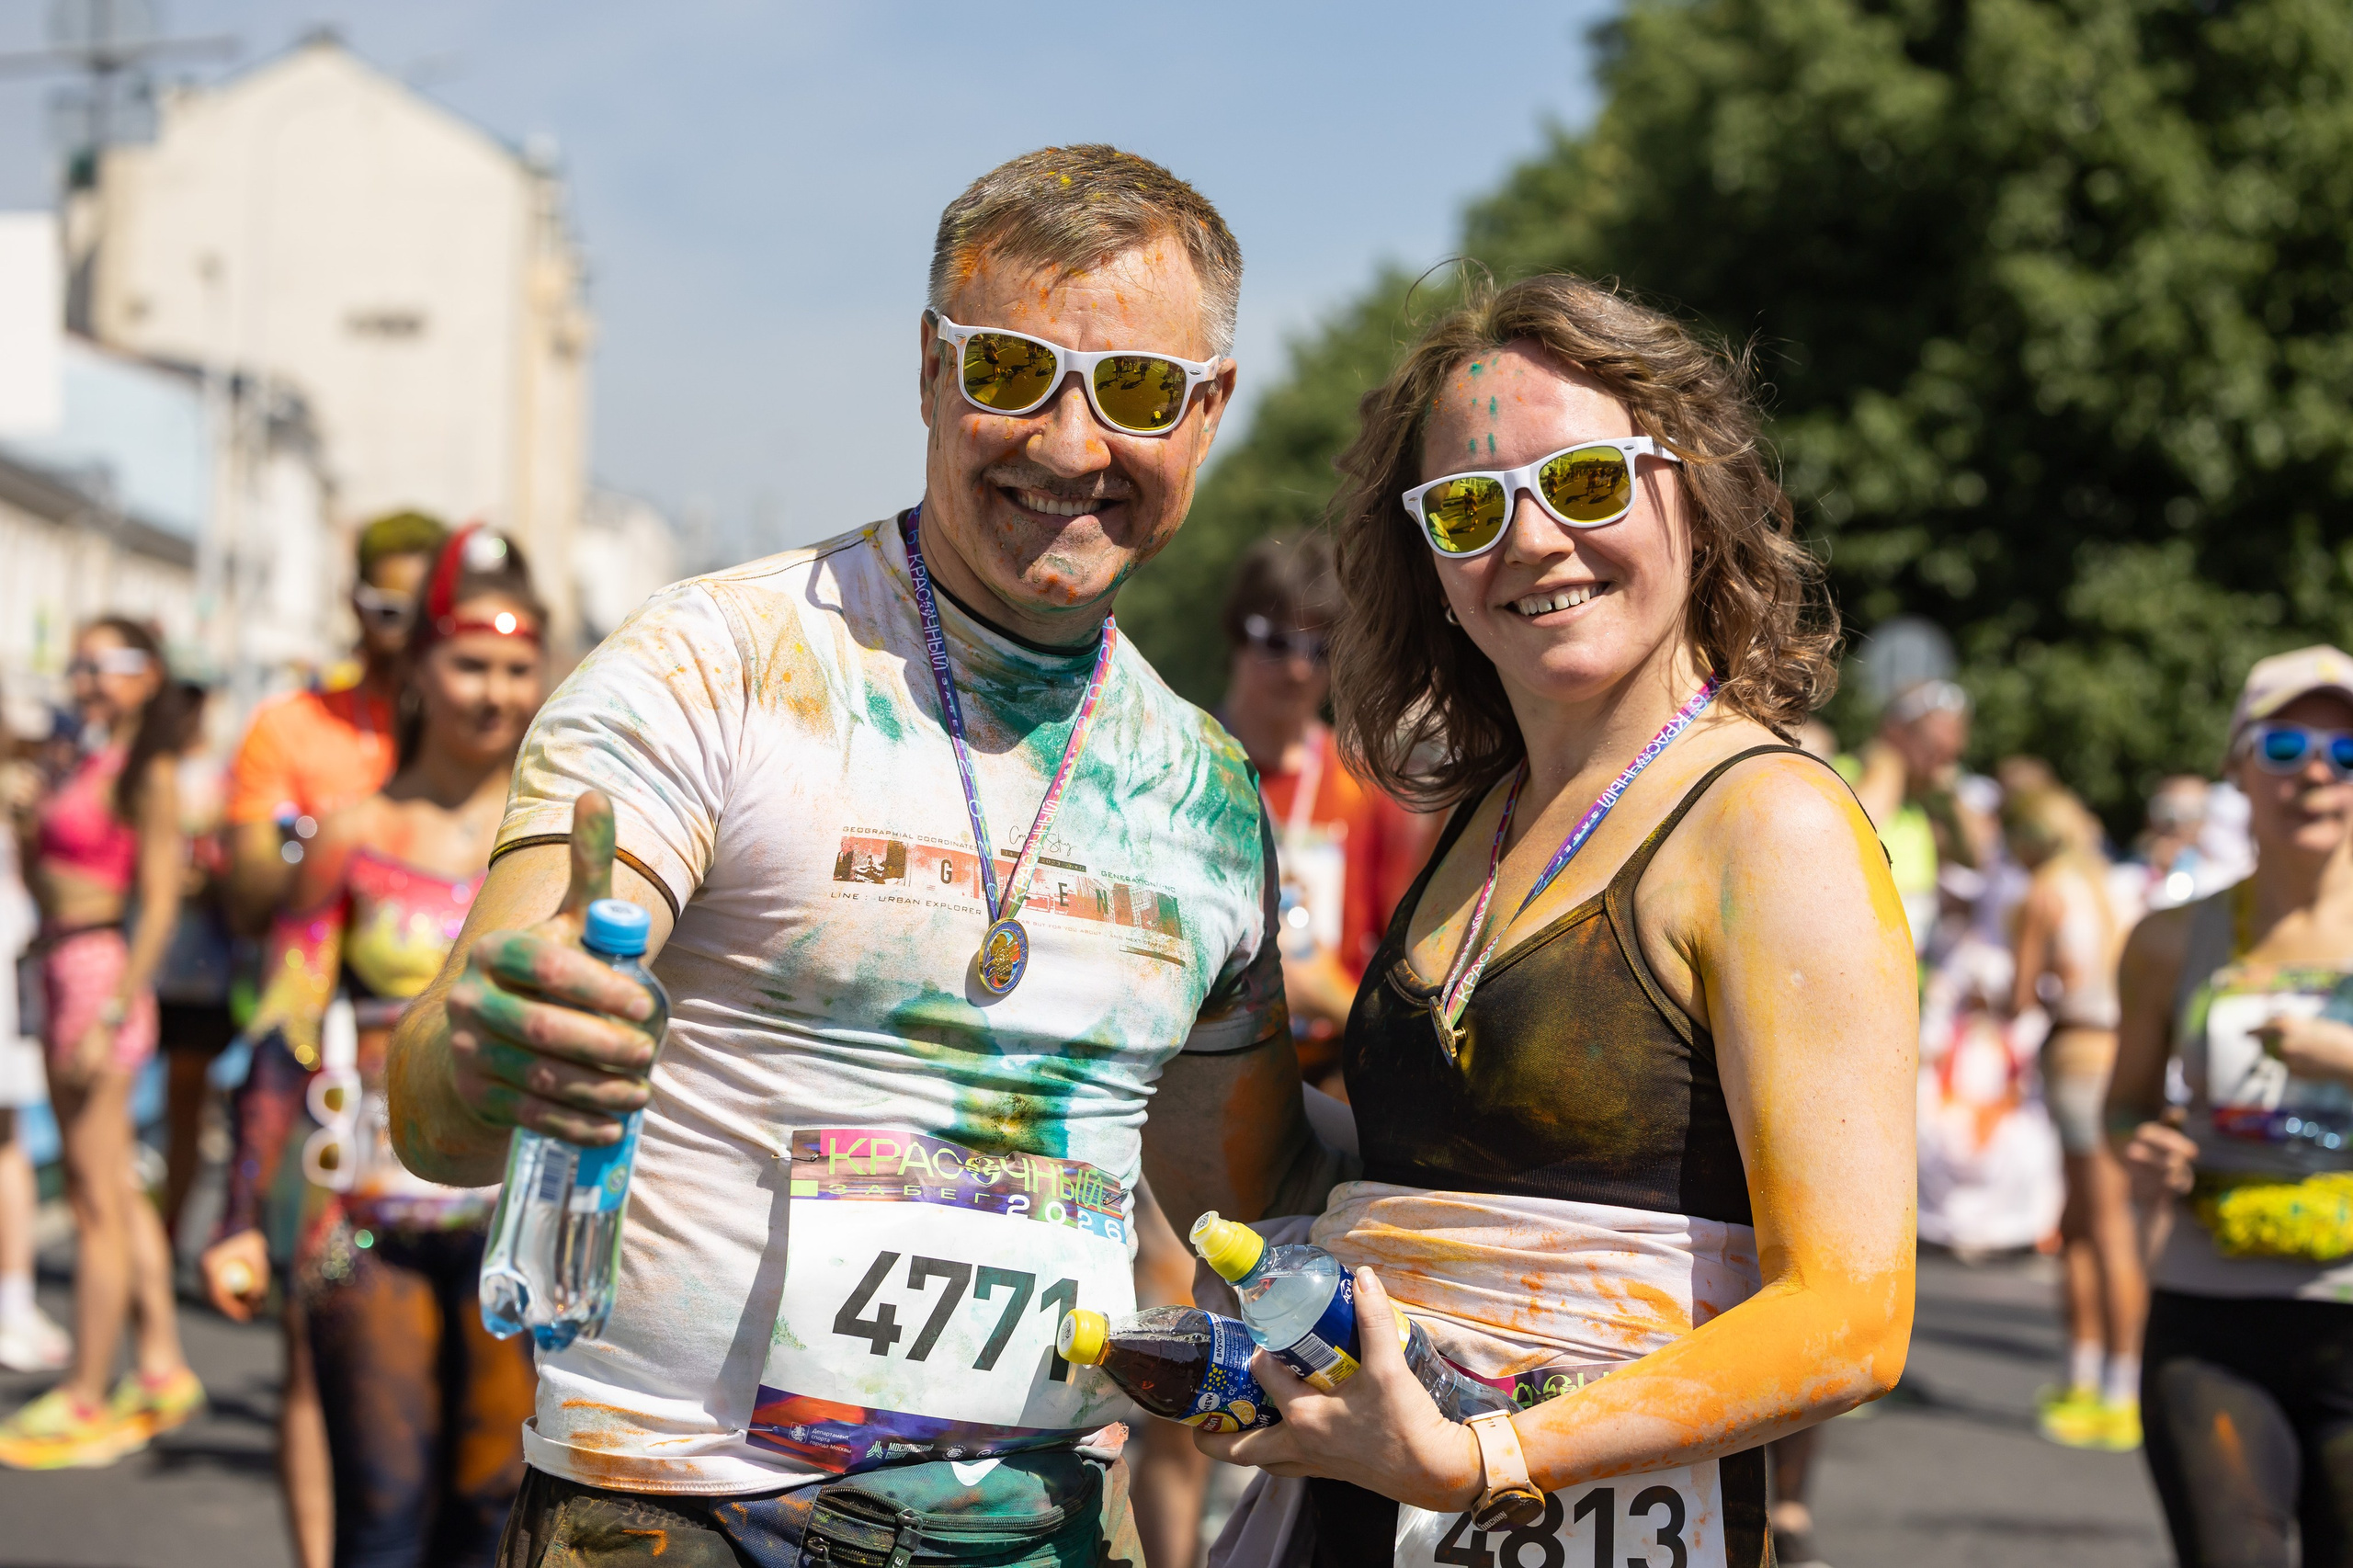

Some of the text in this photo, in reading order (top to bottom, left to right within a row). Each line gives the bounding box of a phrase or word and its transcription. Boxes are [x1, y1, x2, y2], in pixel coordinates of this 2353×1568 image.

[830, 892, 860, 901] LINE
[878, 895, 921, 905] URBAN
[926, 900, 983, 915] EXPLORER
[828, 1137, 1104, 1212] КРАСОЧНЫЙ
[828, 1184, 991, 1204] ЗАБЕГ
[1006, 1194, 1122, 1243] 2026
[832, 1250, 1079, 1382] 4771
[811, 1434, 831, 1443] спорта
[812, 1427, 849, 1440] Департамент
[1434, 1485, 1688, 1568] 4813
